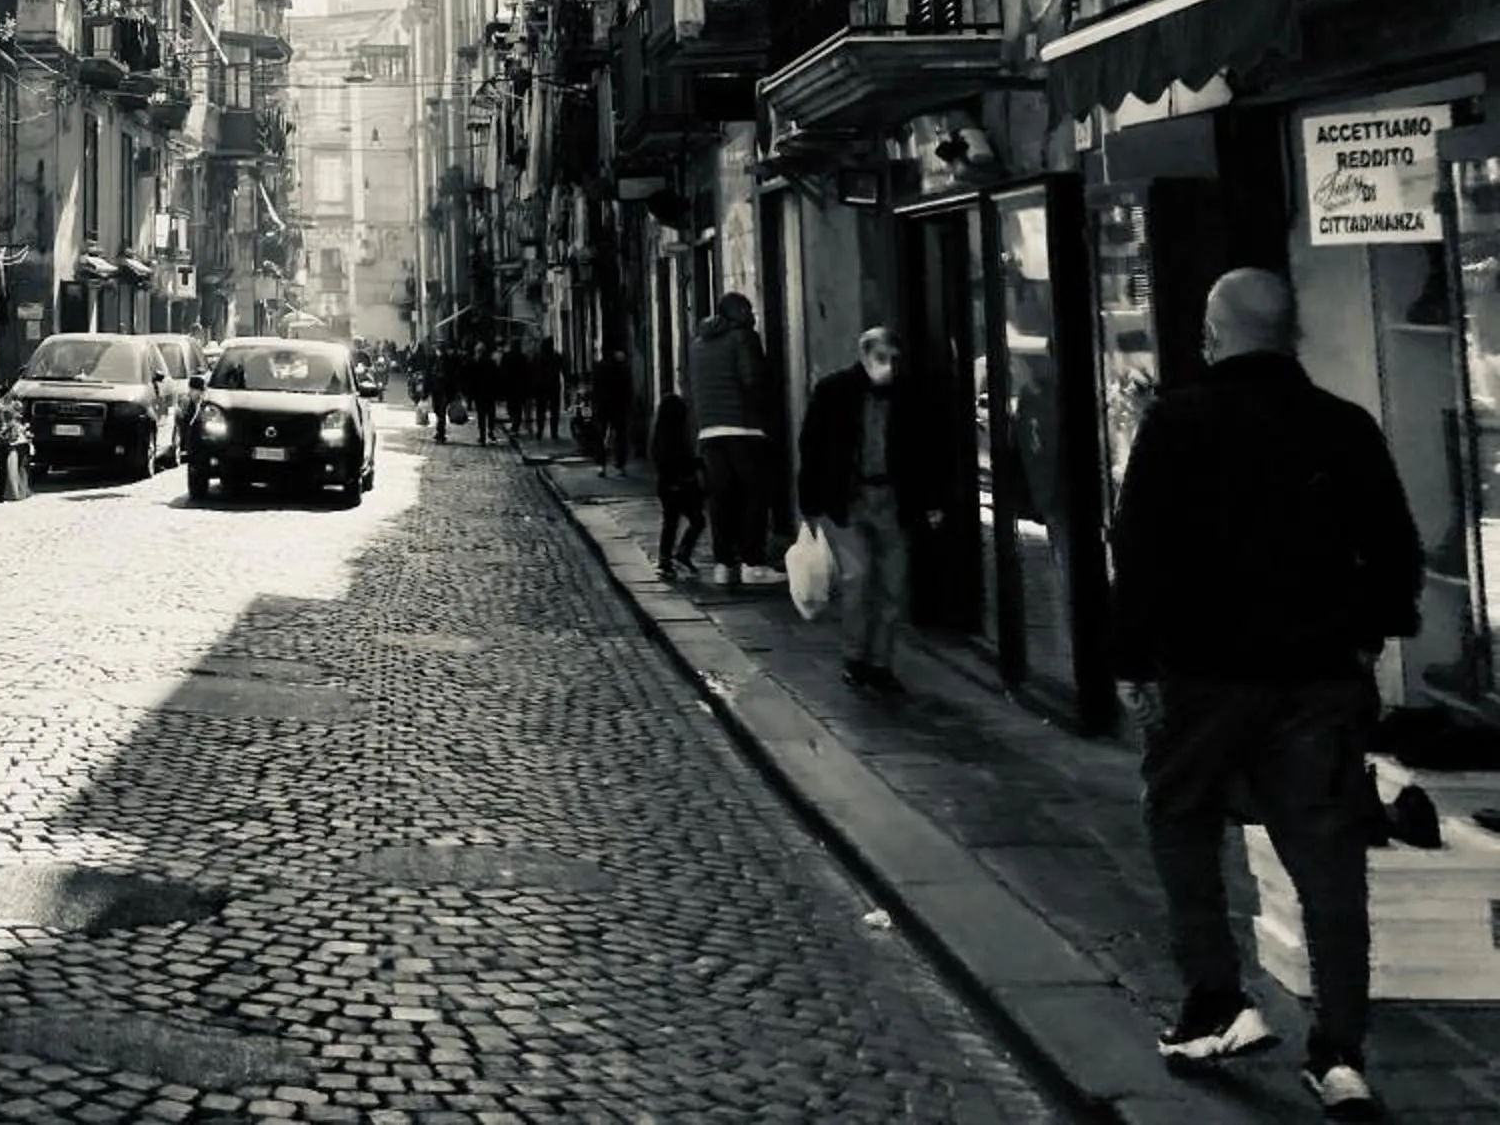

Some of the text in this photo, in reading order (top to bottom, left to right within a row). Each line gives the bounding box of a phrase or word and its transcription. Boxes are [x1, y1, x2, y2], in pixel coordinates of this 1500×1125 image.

[1317, 117, 1431, 143] ACCETTIAMO
[1337, 147, 1414, 169] REDDITO
[1320, 213, 1424, 234] CITTADINANZA
[178, 266, 193, 286] T
